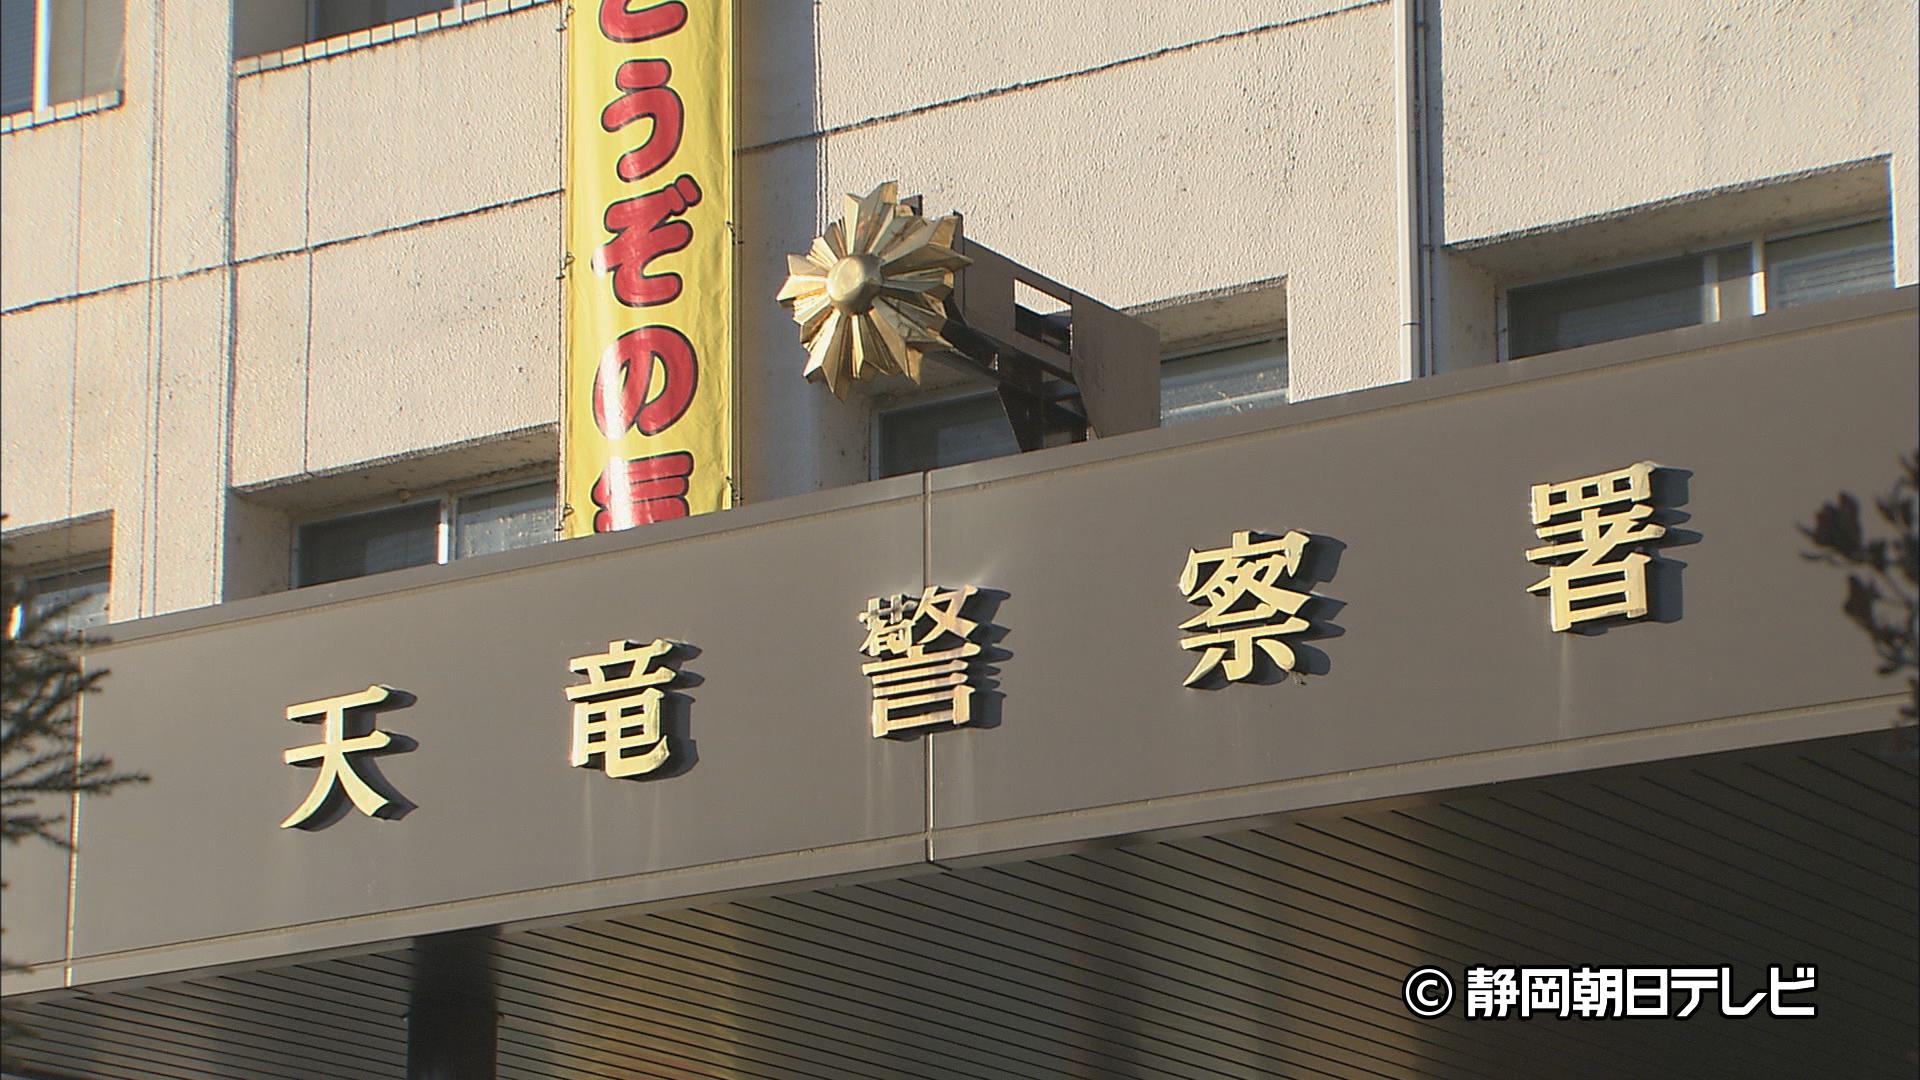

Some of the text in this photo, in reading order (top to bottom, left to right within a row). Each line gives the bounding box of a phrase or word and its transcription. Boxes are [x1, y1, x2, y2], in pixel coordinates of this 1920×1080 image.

[281, 461, 1666, 831] 天竜警察署
